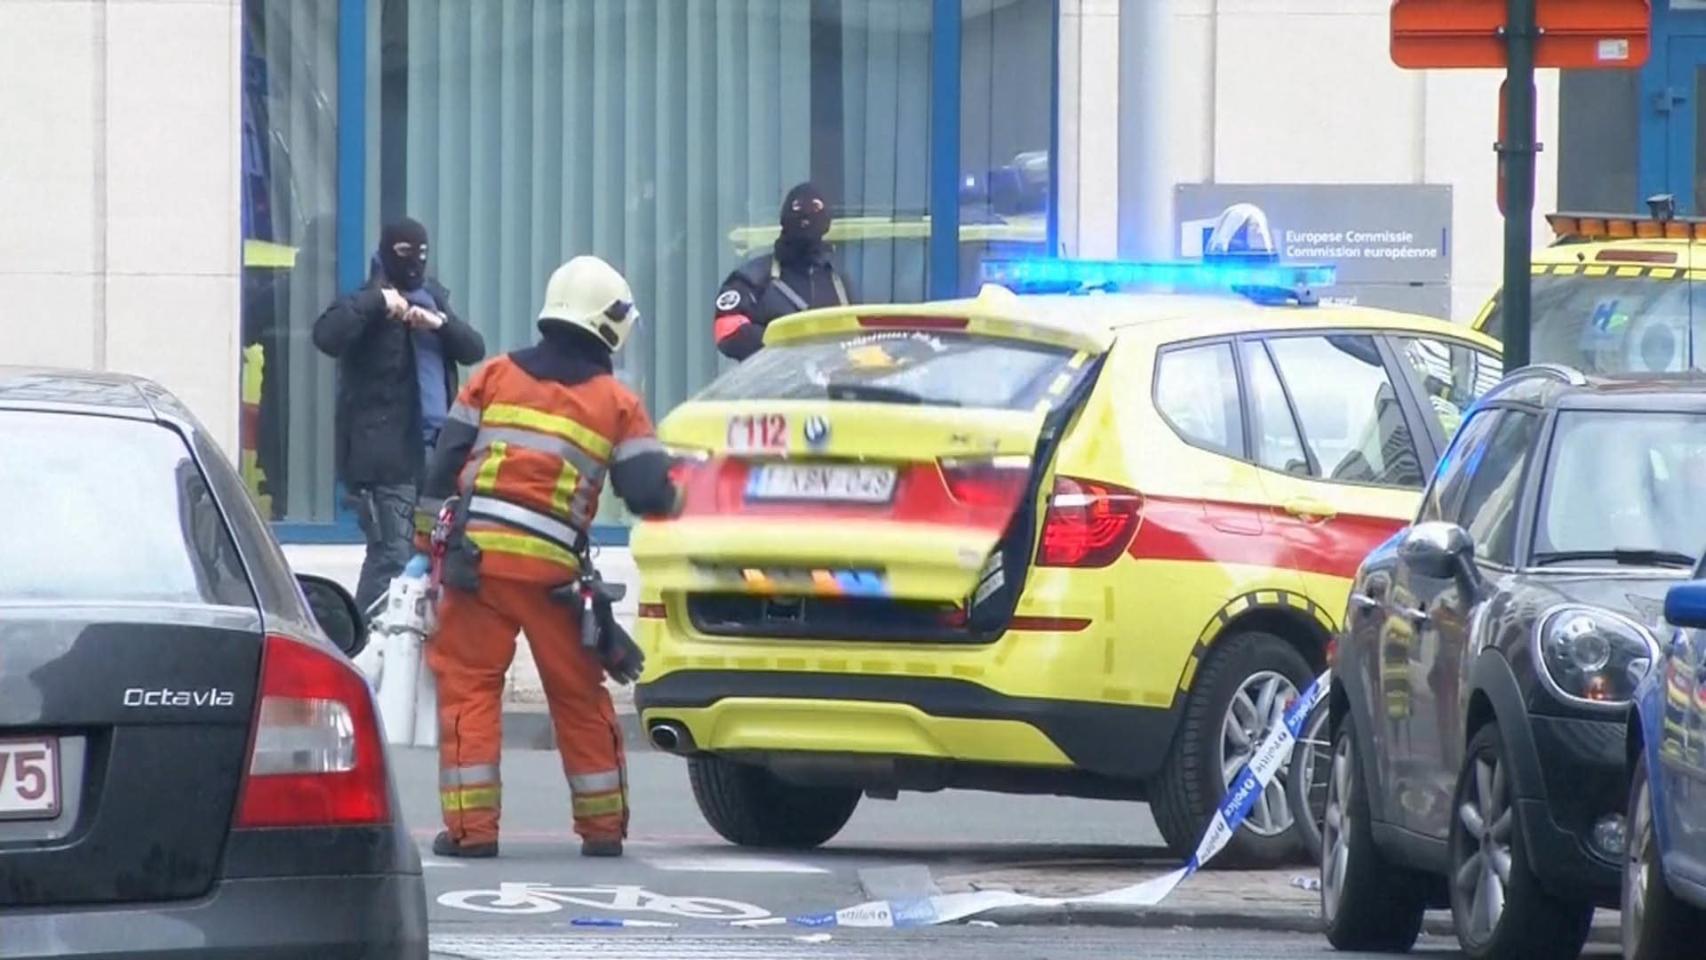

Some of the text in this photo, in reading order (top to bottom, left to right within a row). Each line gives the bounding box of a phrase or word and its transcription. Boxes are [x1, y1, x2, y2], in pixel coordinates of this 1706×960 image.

[1286, 231, 1413, 243] Europese Commissie
[1287, 245, 1437, 259] Commission européenne
[746, 413, 785, 446] 112
[123, 688, 234, 706] Octavia
[1224, 787, 1249, 817] Police
